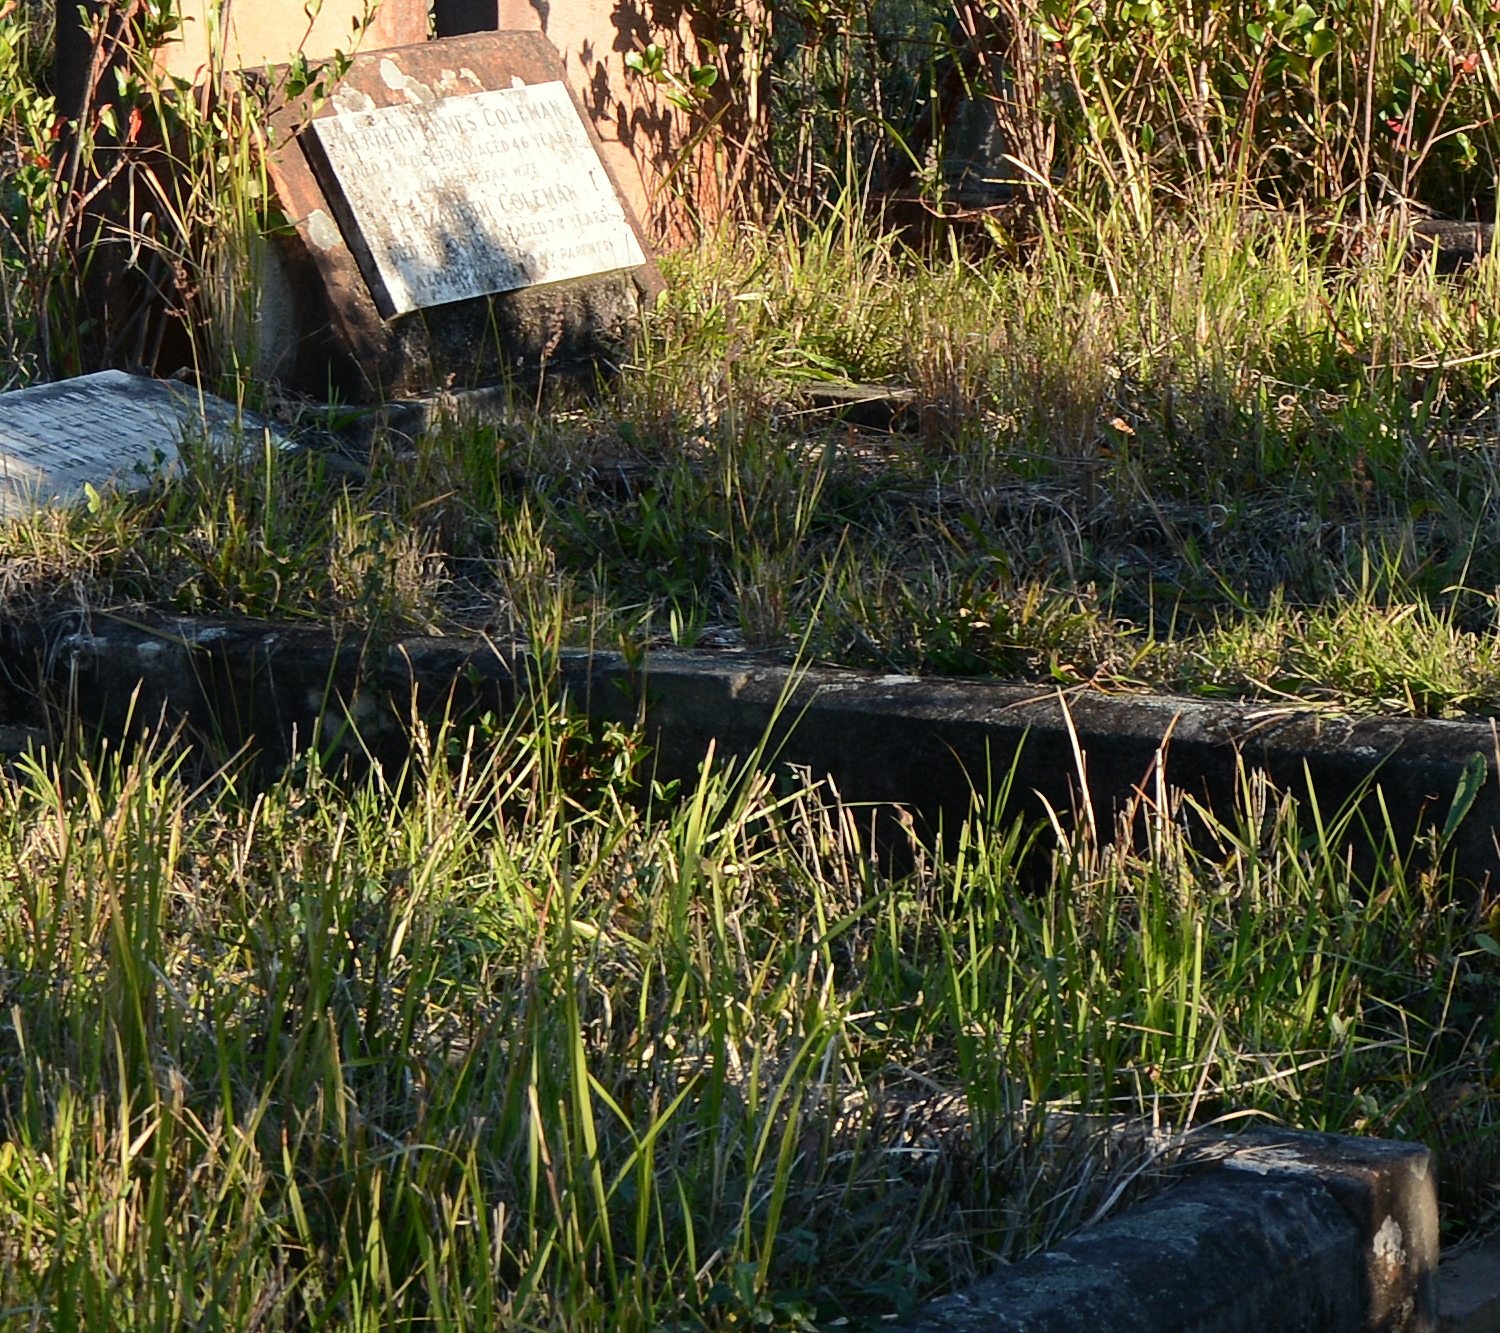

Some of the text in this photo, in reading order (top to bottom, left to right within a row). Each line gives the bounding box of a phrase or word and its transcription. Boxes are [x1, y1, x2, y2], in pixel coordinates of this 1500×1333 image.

[479, 96, 566, 130] COLEMAN
[509, 135, 530, 150] 46
[495, 179, 580, 214] COLEMAN
